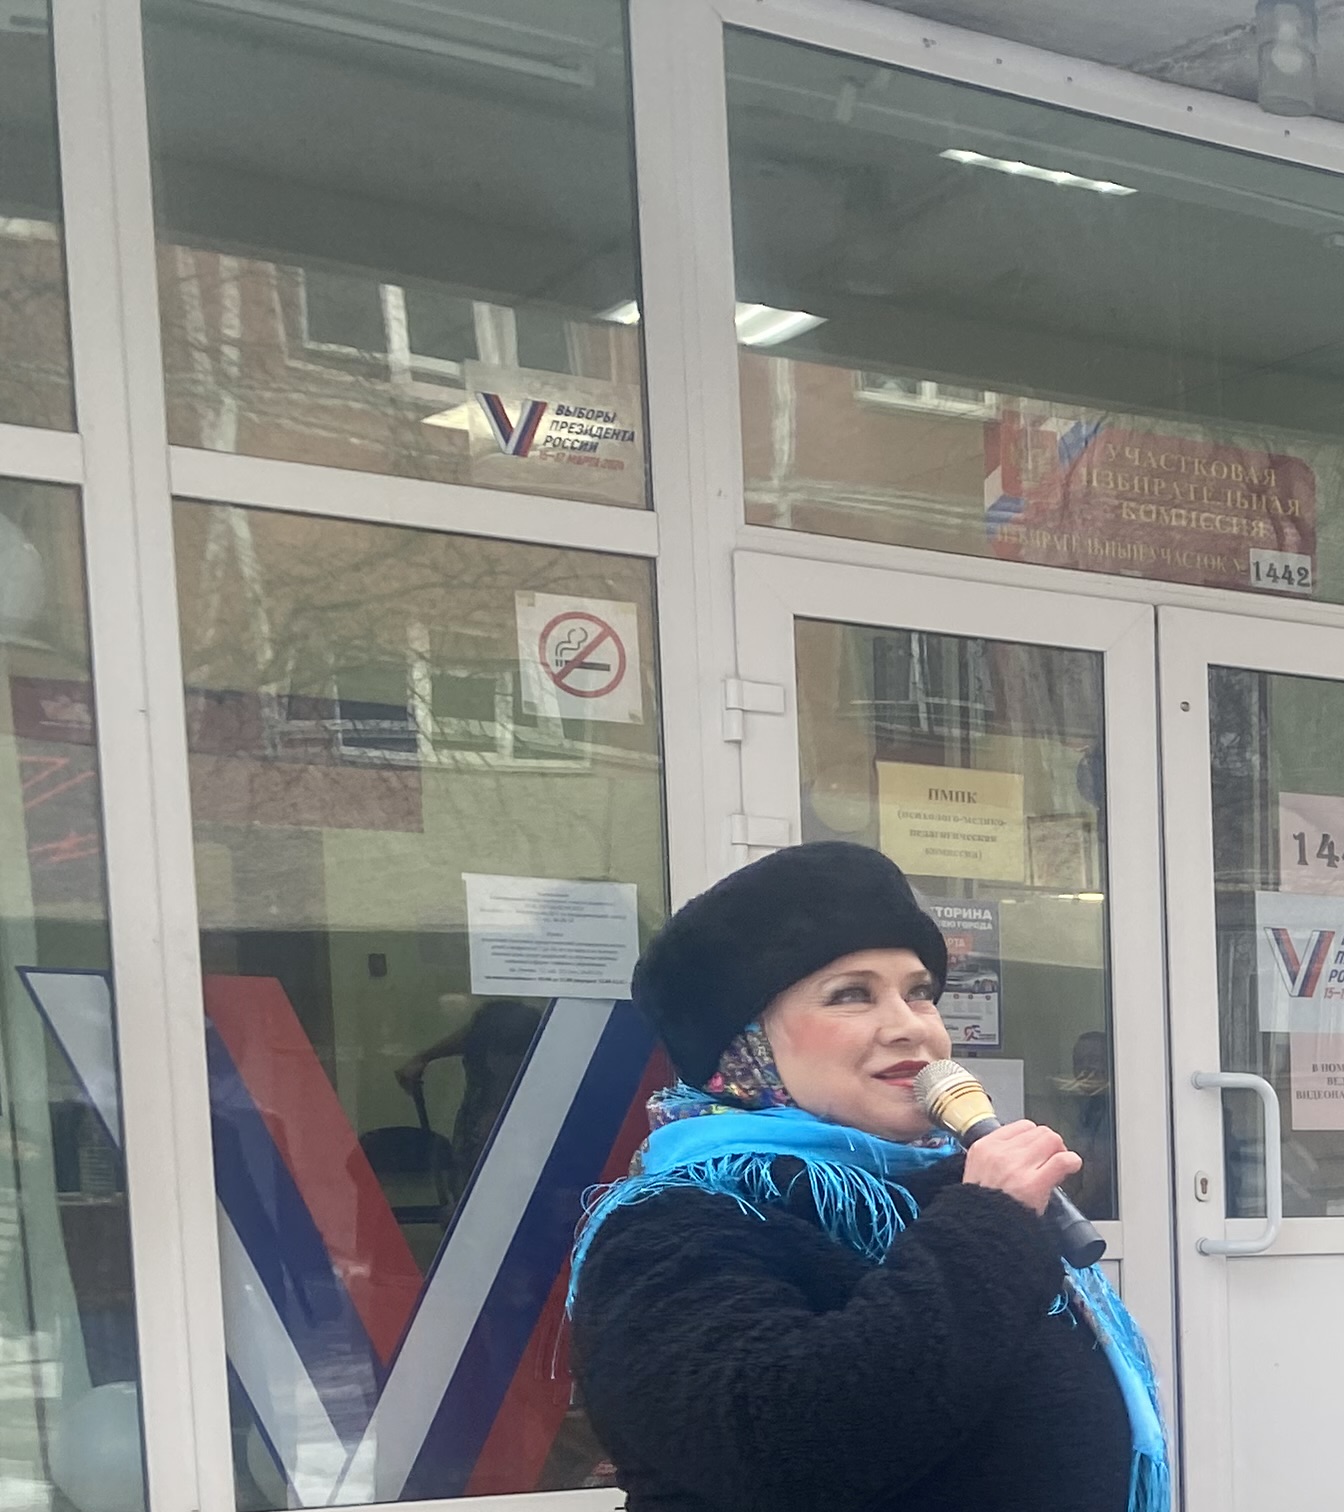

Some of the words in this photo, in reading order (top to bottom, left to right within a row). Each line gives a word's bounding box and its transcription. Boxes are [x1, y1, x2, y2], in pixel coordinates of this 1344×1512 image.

[556, 404, 617, 423] ВЫБОРЫ
[549, 420, 635, 442] ПРЕЗИДЕНТА
[543, 435, 599, 453] РОССИИ
[1107, 443, 1276, 488] УЧАСТКОВАЯ
[1081, 467, 1300, 517] ИЗБИРАТЕЛЬНАЯ
[1121, 501, 1267, 538] КОМИССИЯ
[1252, 561, 1311, 588] 1442
[928, 788, 978, 804] ПМПК
[930, 906, 993, 920] ТОРИНА
